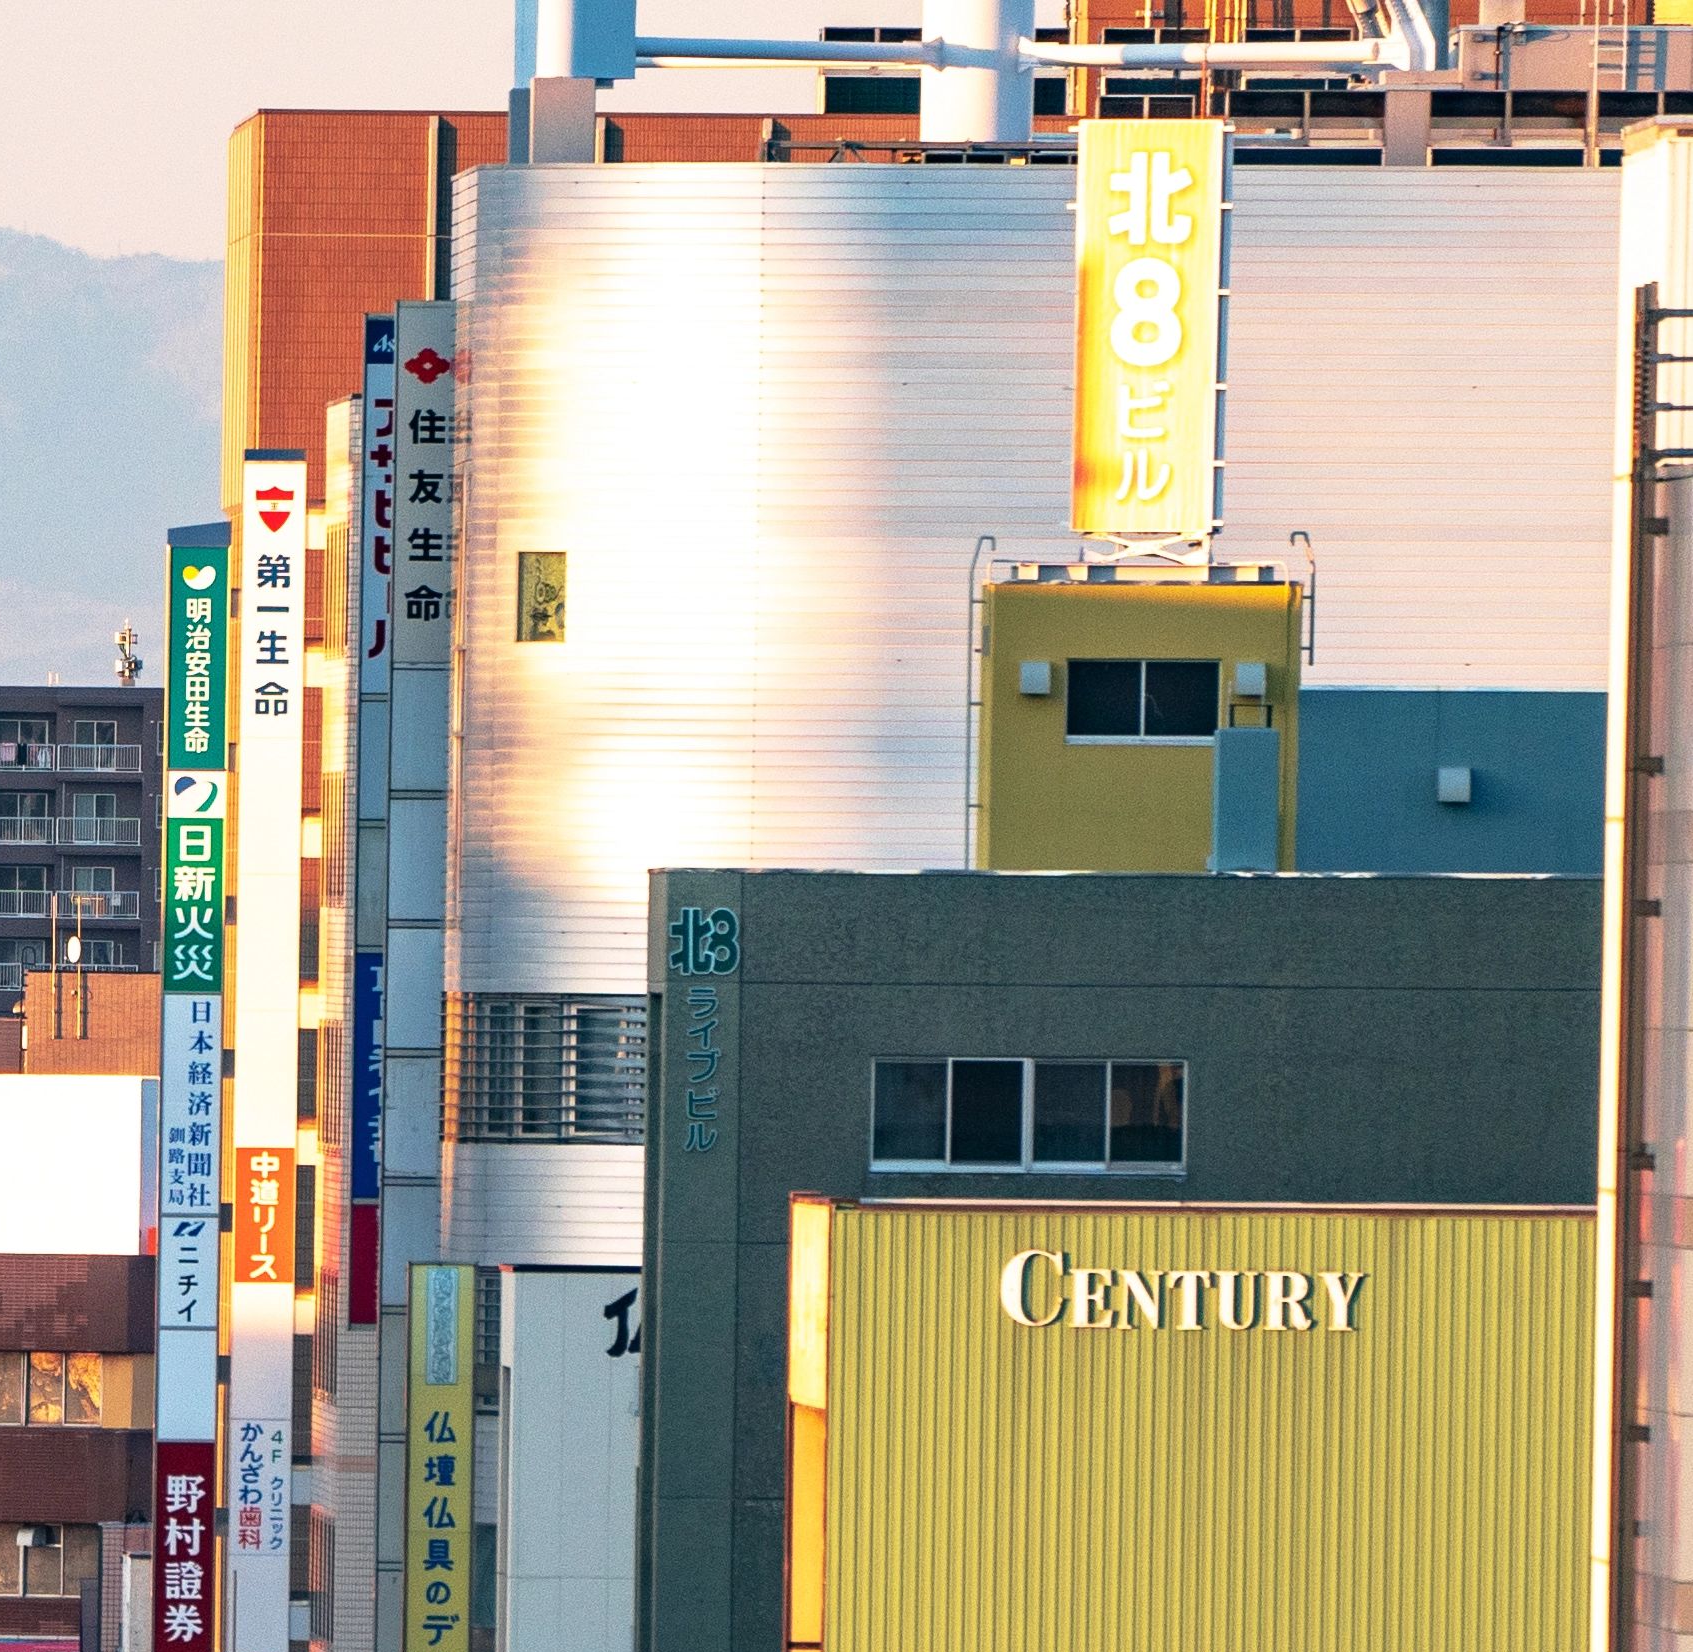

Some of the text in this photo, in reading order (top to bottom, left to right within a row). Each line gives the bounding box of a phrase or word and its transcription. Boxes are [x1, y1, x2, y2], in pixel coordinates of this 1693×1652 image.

[1106, 152, 1194, 505] 北8ビル
[404, 409, 446, 623] 住友生命
[184, 598, 212, 755] 明治安田生命
[253, 553, 291, 717] 第一生命
[172, 825, 216, 982] 日新火災
[187, 1001, 213, 1208] 日本経済新聞社
[684, 988, 719, 1152] ライブビル
[167, 1127, 186, 1206] 釧路支局
[248, 1151, 280, 1280] 中道リース
[177, 1245, 201, 1323] ニチイ
[162, 1473, 207, 1645] 野村證券
[237, 1421, 266, 1551] かんざわ歯科
[268, 1474, 286, 1552] クリニック
